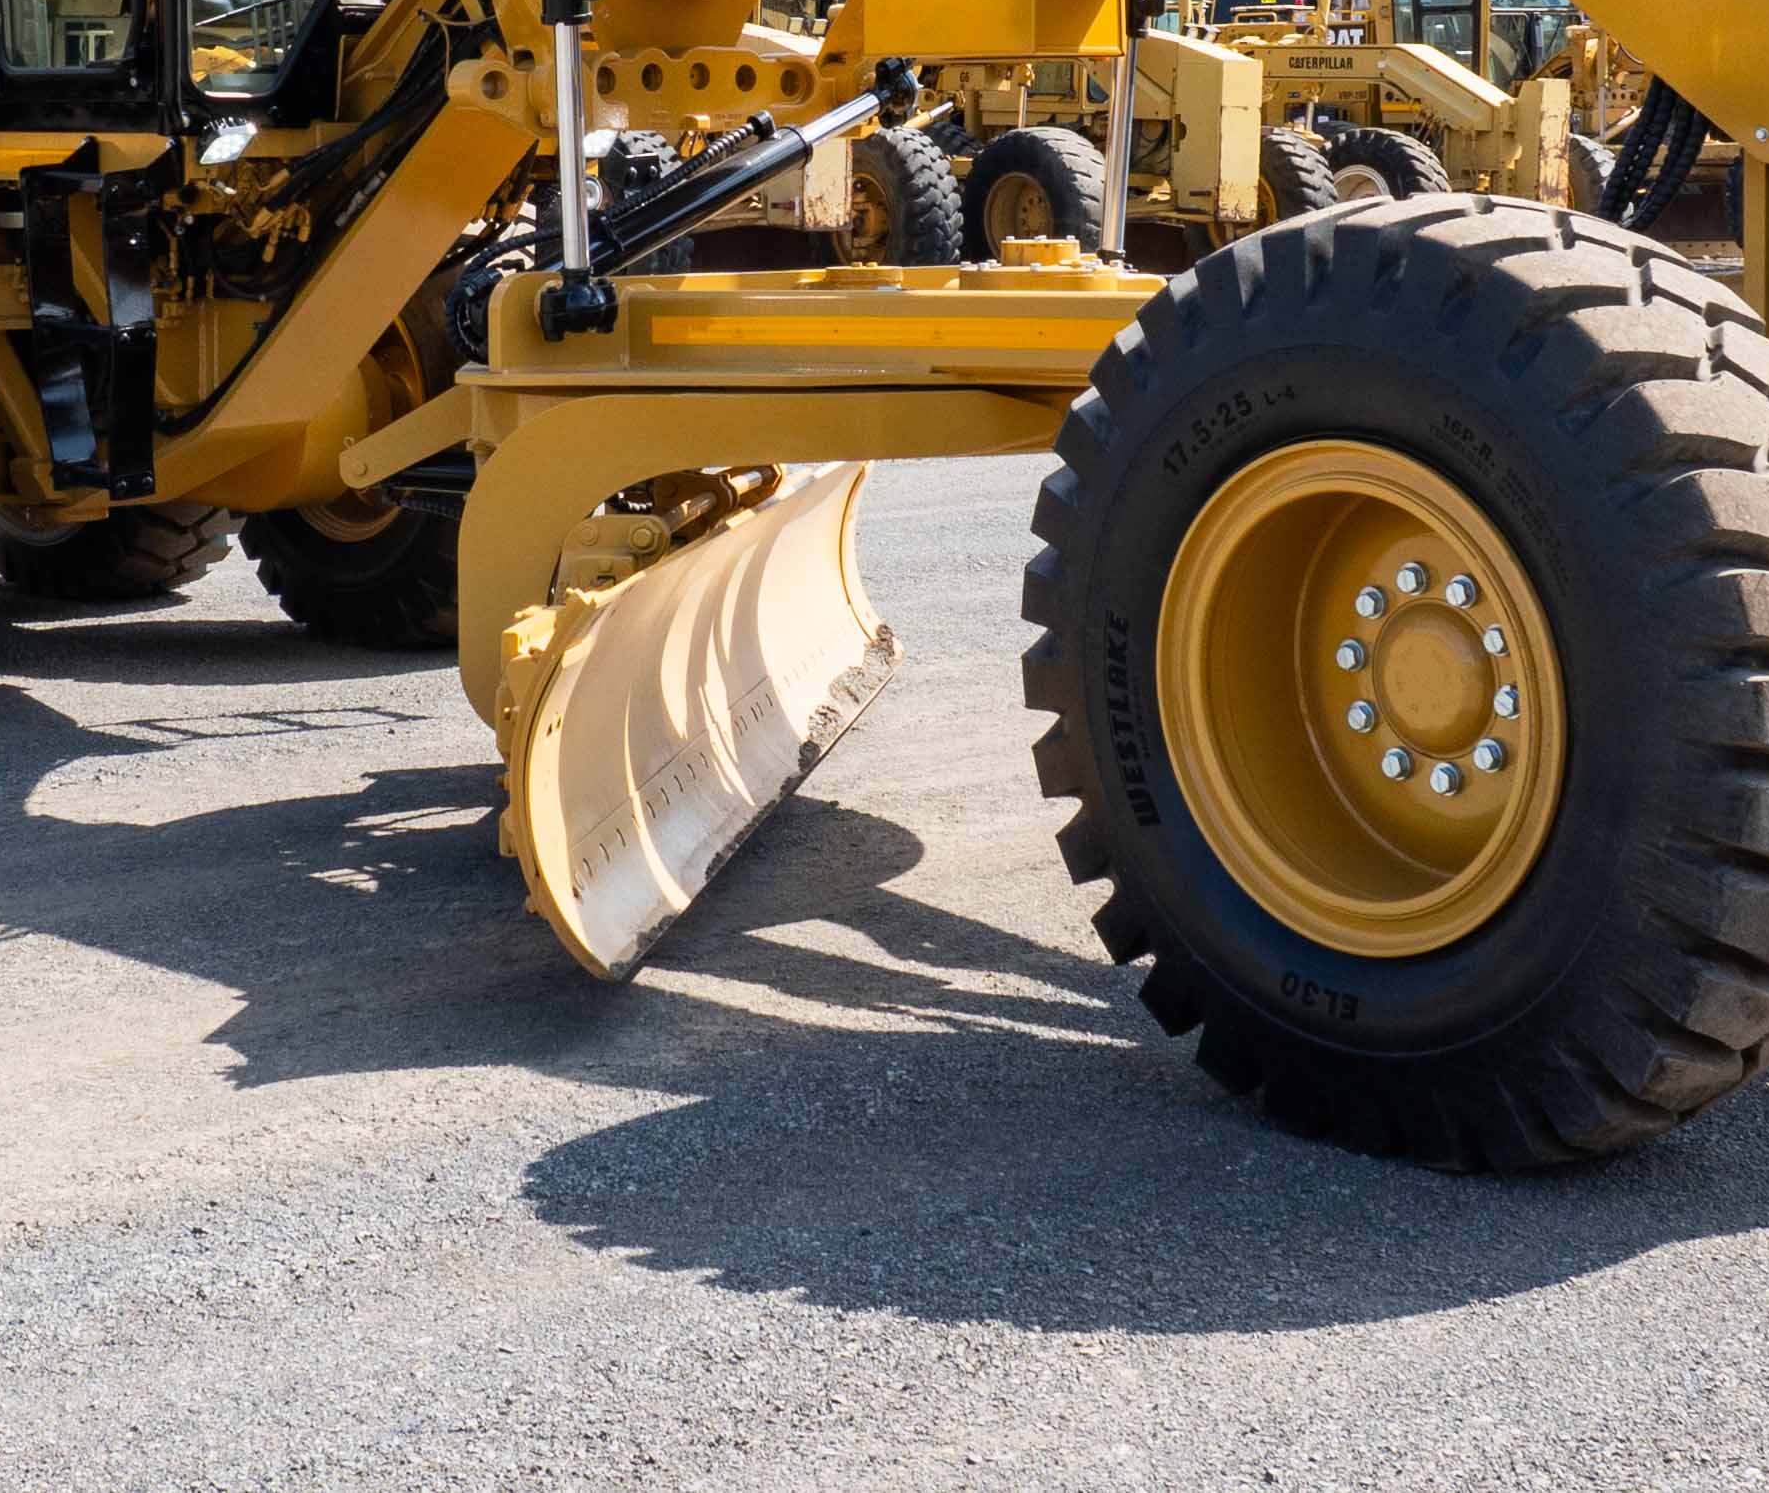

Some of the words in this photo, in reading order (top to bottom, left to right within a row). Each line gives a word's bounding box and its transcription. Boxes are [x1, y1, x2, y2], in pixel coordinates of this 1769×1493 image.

[1288, 57, 1354, 70] CATERPILLAR
[1106, 608, 1162, 827] WESTLAKE
[1280, 970, 1359, 1023] EL30
